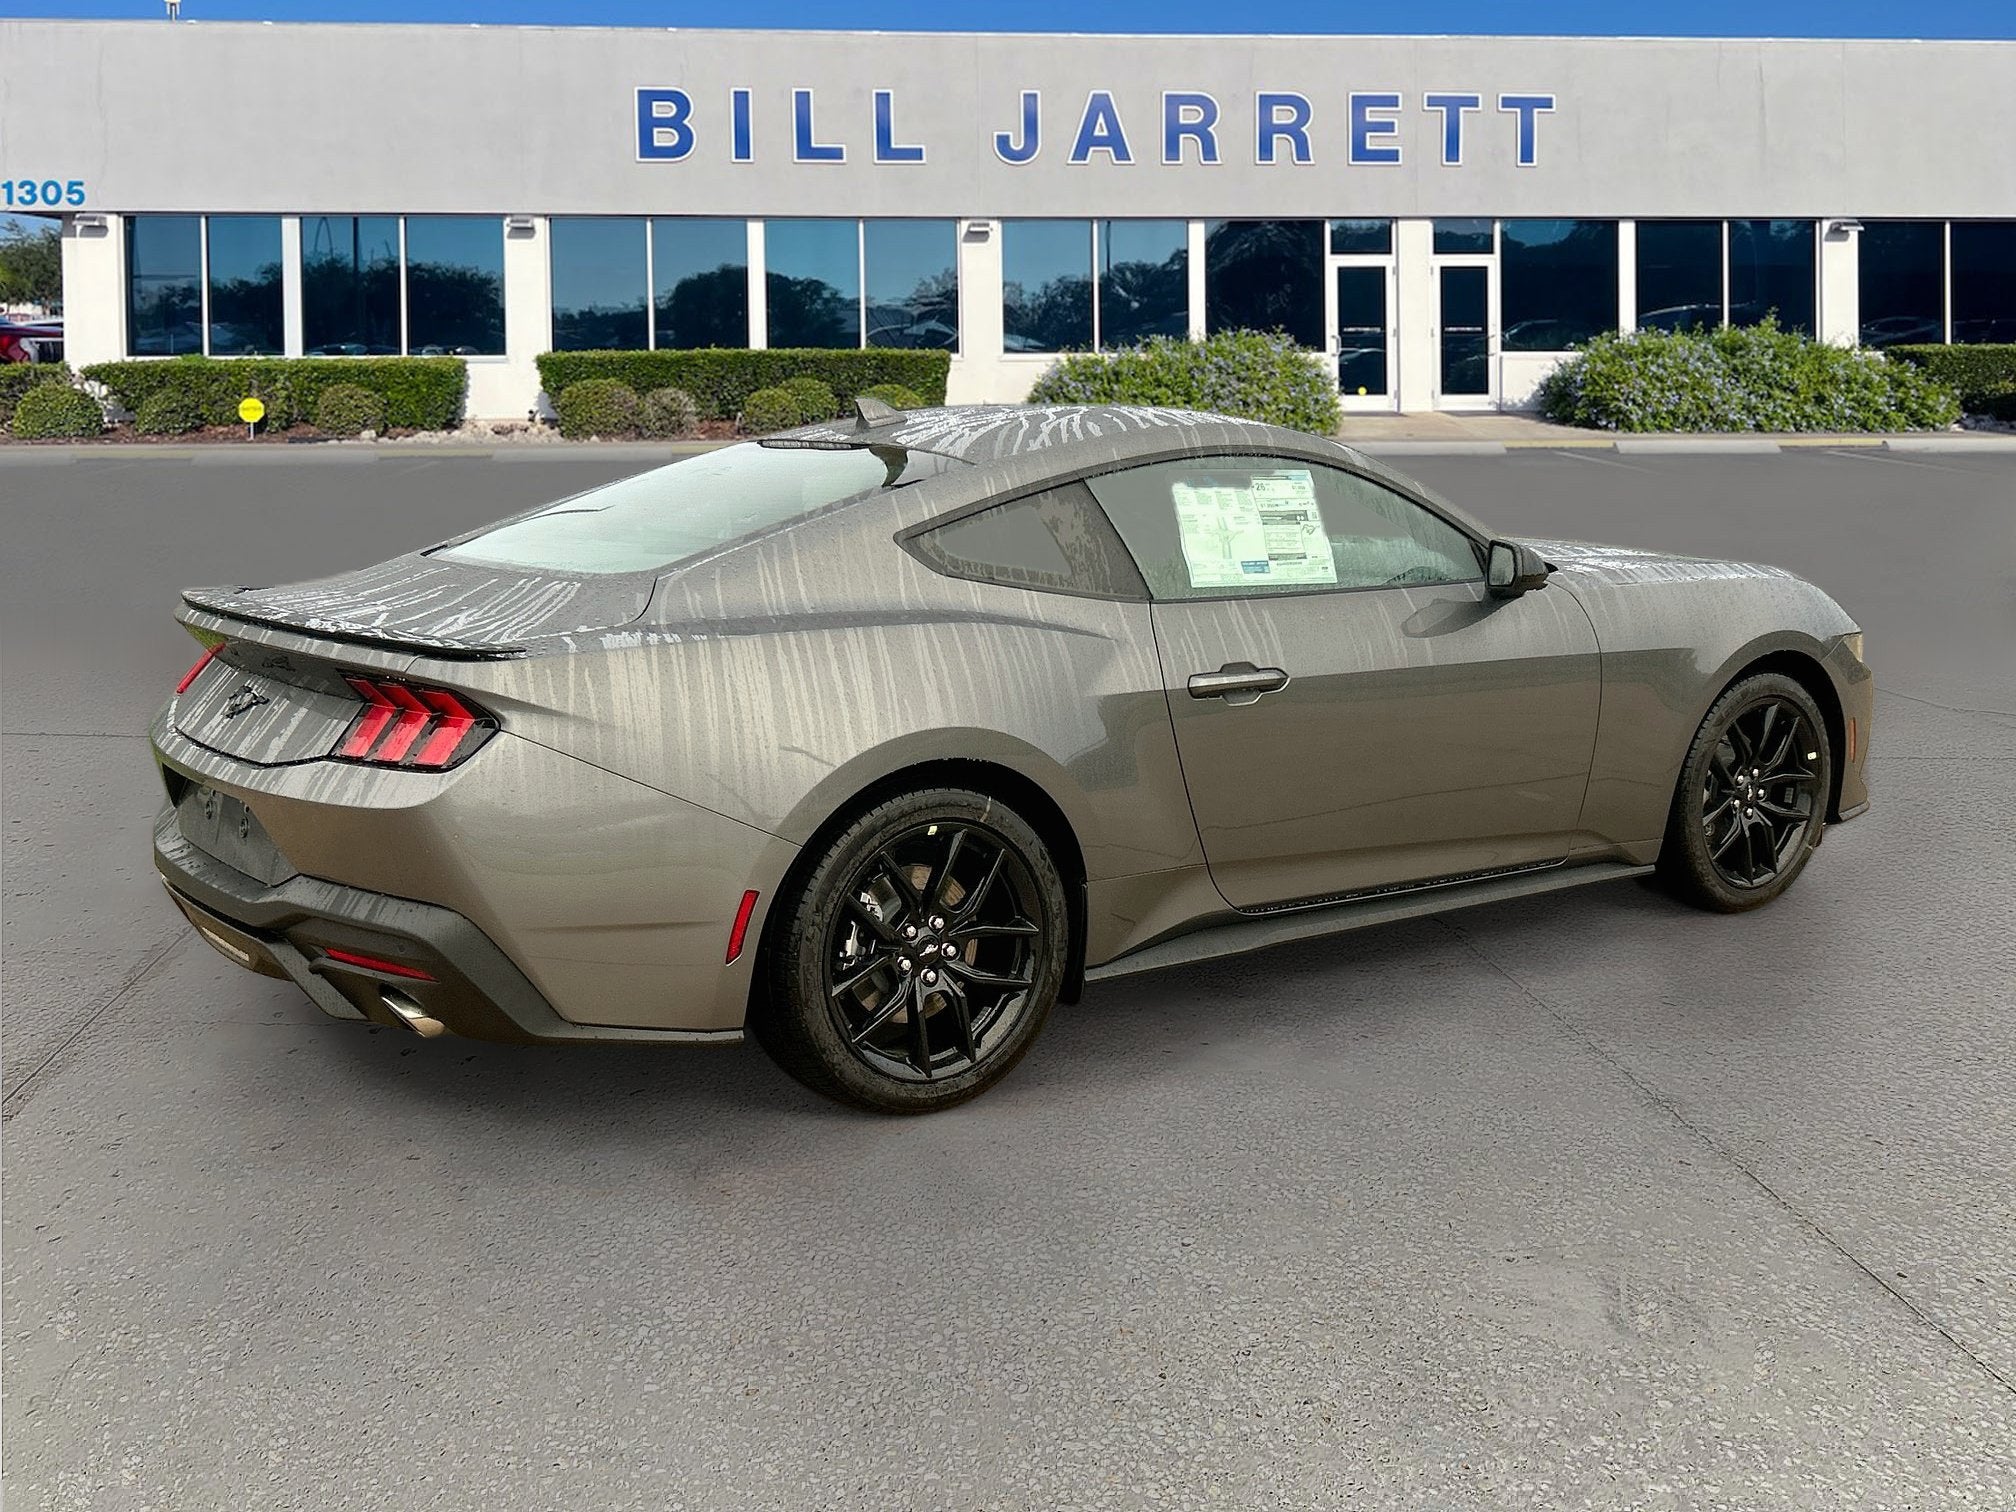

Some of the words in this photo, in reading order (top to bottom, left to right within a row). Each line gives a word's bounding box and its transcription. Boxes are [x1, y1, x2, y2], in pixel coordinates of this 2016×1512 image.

[634, 86, 926, 164] BILL
[993, 90, 1556, 167] JARRETT
[1, 180, 86, 206] 1305
